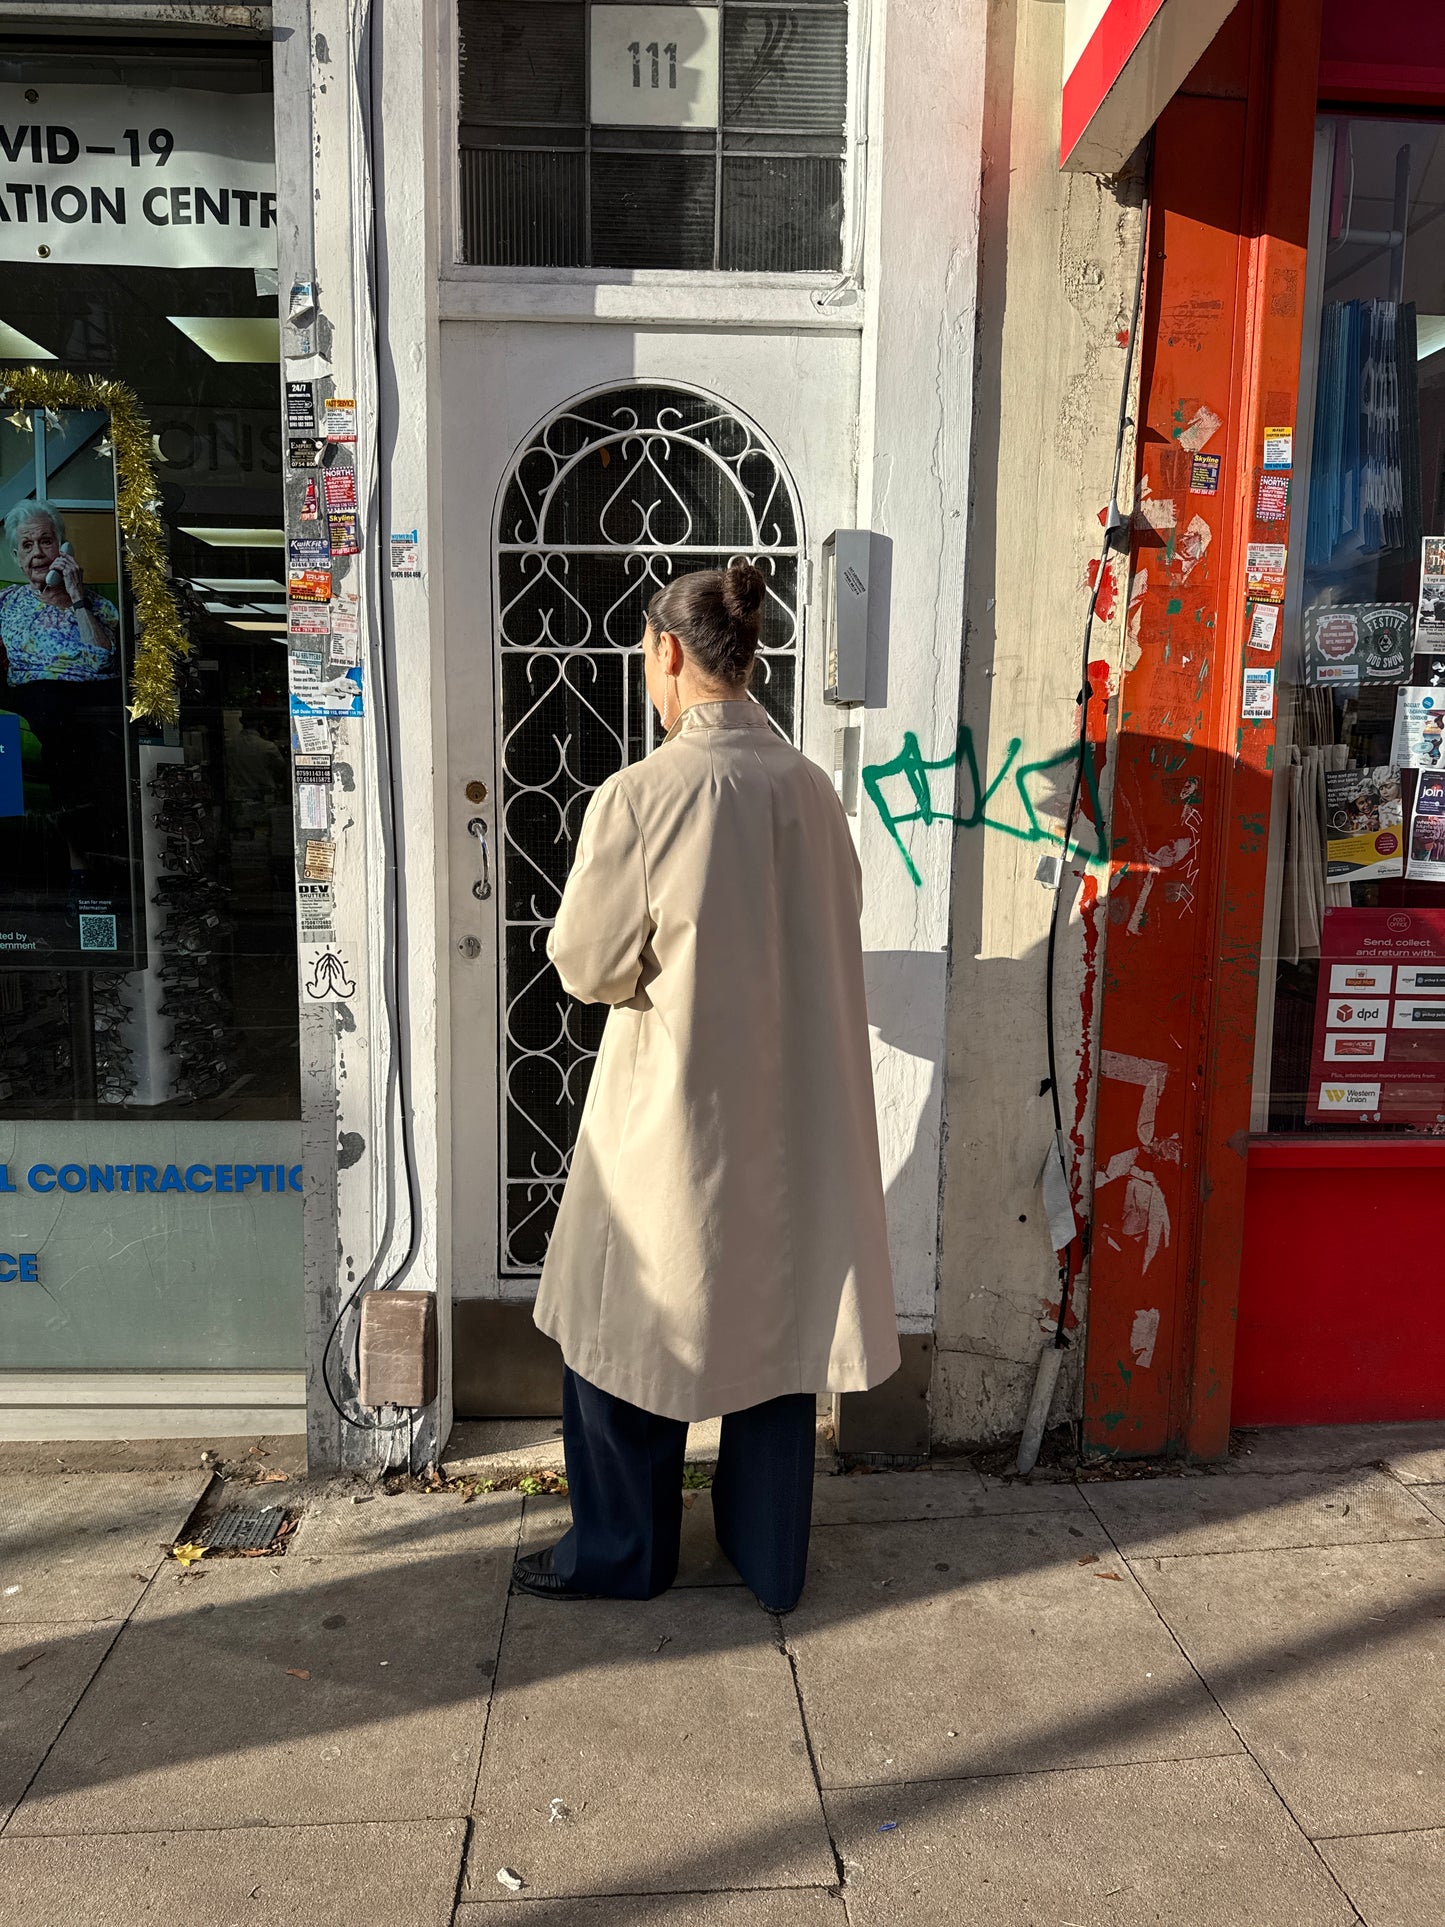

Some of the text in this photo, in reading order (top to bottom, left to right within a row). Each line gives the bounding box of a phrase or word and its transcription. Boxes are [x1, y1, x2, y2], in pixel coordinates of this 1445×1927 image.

[627, 41, 677, 88] 111
[0, 183, 126, 225] TION
[292, 384, 306, 392] 24/7
[1194, 455, 1219, 463] Skyline
[325, 469, 351, 477] NORTH
[1263, 478, 1286, 486] NORTH
[411, 529, 417, 543] 1
[1366, 617, 1405, 632] FESTIVE
[1366, 652, 1404, 668] DOG SHOW
[1266, 670, 1271, 683] 1
[1420, 786, 1443, 798] join
[16, 932, 27, 942] by
[1364, 938, 1431, 947] Send, collect
[1357, 1008, 1379, 1021] dpd
[0, 1164, 17, 1192] L
